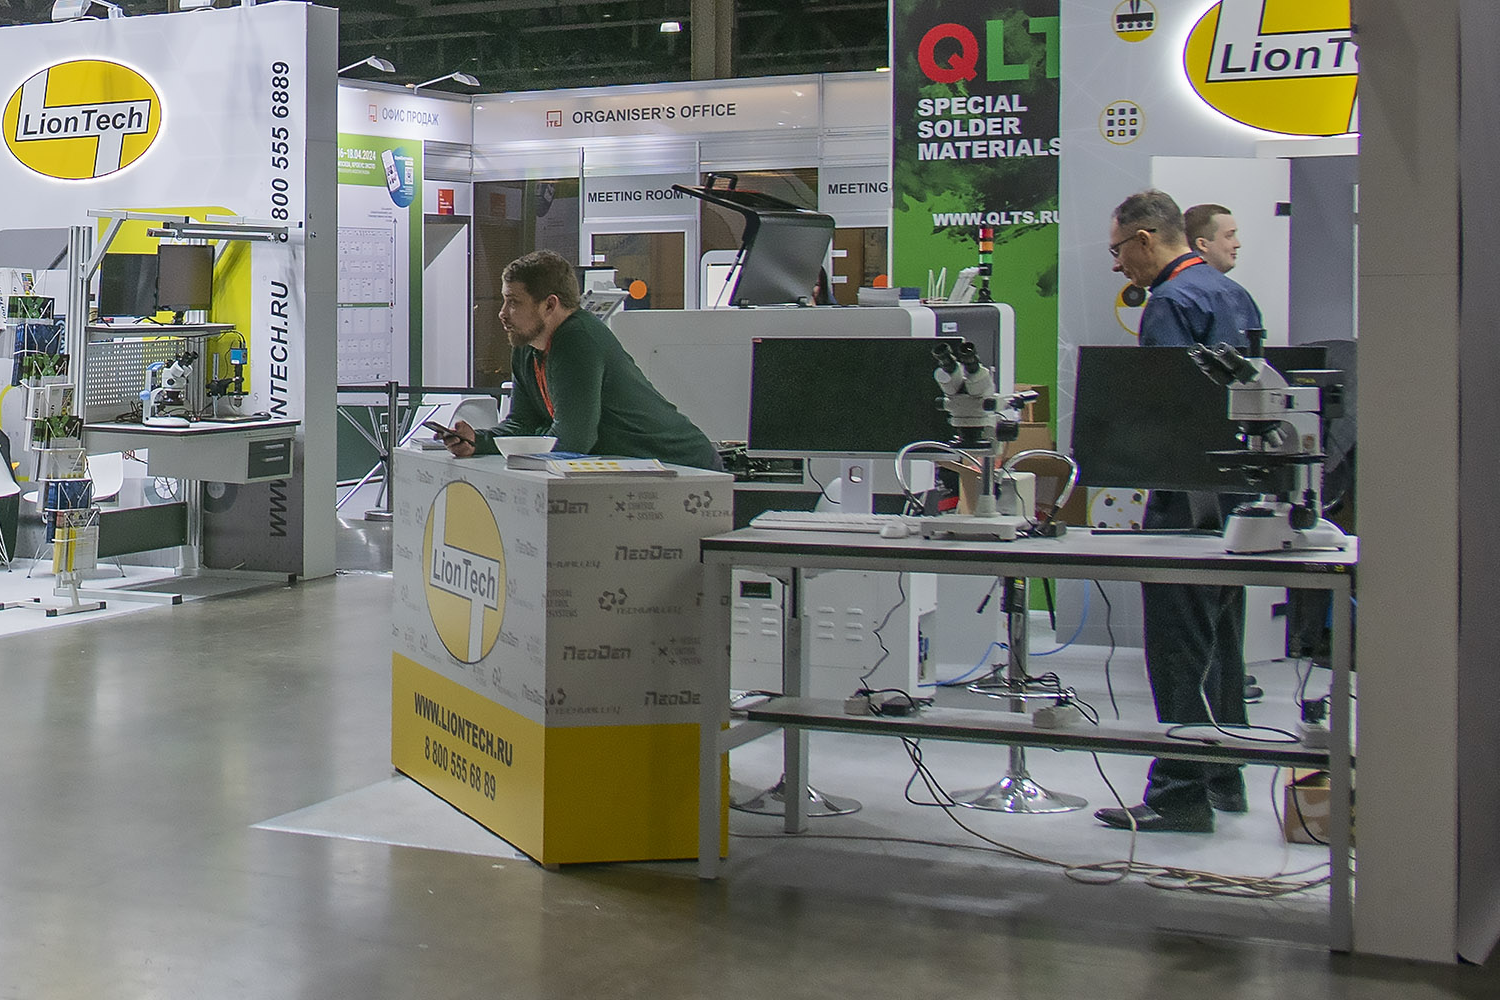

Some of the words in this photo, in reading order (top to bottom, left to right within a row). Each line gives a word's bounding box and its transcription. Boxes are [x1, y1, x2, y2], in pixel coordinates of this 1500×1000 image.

[1219, 36, 1358, 74] LionT
[272, 61, 290, 119] 6889
[382, 107, 405, 122] ОФИС
[406, 110, 440, 126] ПРОДАЖ
[680, 103, 737, 118] OFFICE
[917, 94, 1028, 117] SPECIAL
[22, 106, 144, 136] LionTech
[917, 117, 1022, 139] SOLDER
[272, 127, 289, 170] 555
[917, 137, 1061, 161] MATERIALS
[271, 178, 289, 221] 800
[587, 190, 642, 203] MEETING
[645, 188, 684, 201] ROOM
[828, 182, 889, 195] MEETING
[432, 548, 496, 600] LionTech
[643, 690, 700, 706] NeoDe
[414, 691, 513, 768] WWW.LIONTECH.RU
[424, 735, 431, 760] 8
[432, 740, 448, 772] 800
[450, 751, 468, 784] 555
[469, 762, 481, 792] 68
[483, 769, 496, 801] 89
